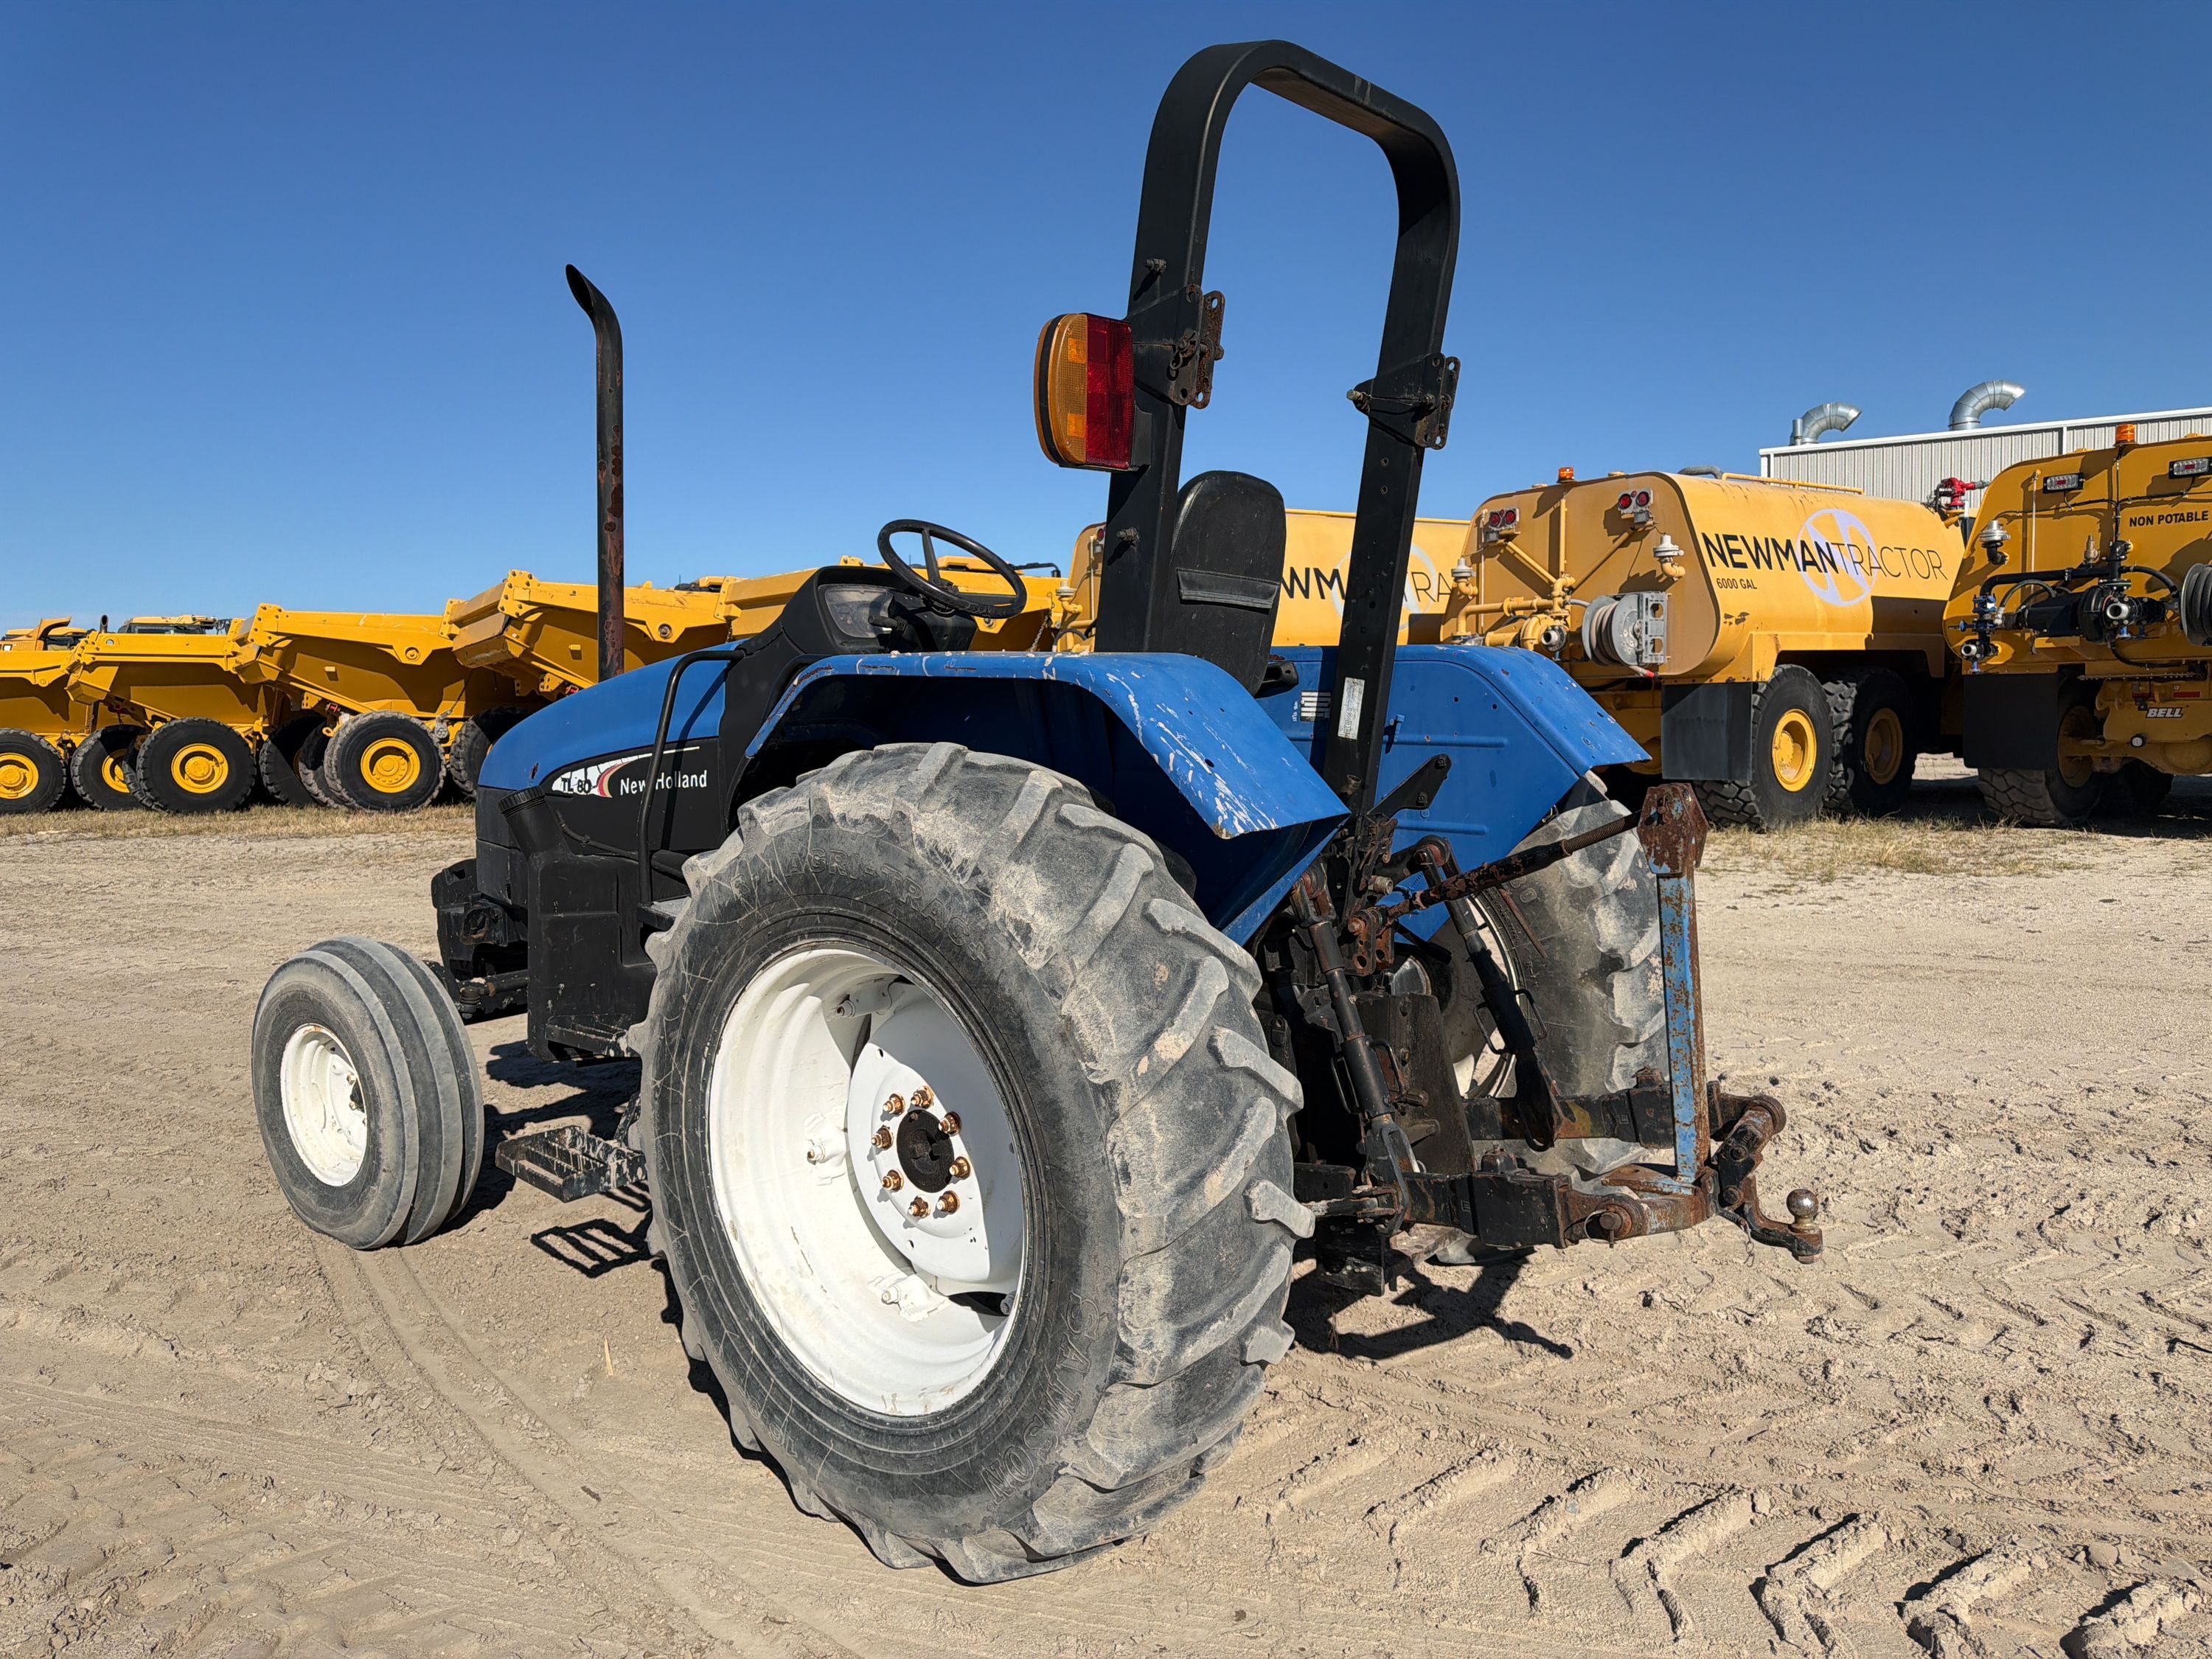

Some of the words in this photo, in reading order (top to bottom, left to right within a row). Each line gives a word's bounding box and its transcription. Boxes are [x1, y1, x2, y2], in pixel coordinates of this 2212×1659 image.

[2129, 515, 2154, 527] NON
[2157, 510, 2209, 525] POTABLE
[1716, 577, 1738, 589] 6000
[1739, 579, 1758, 589] GAL
[2146, 707, 2183, 719] BELL
[561, 777, 574, 793] TL
[577, 779, 592, 794] 80
[620, 777, 646, 796] New
[655, 769, 708, 790] Holland
